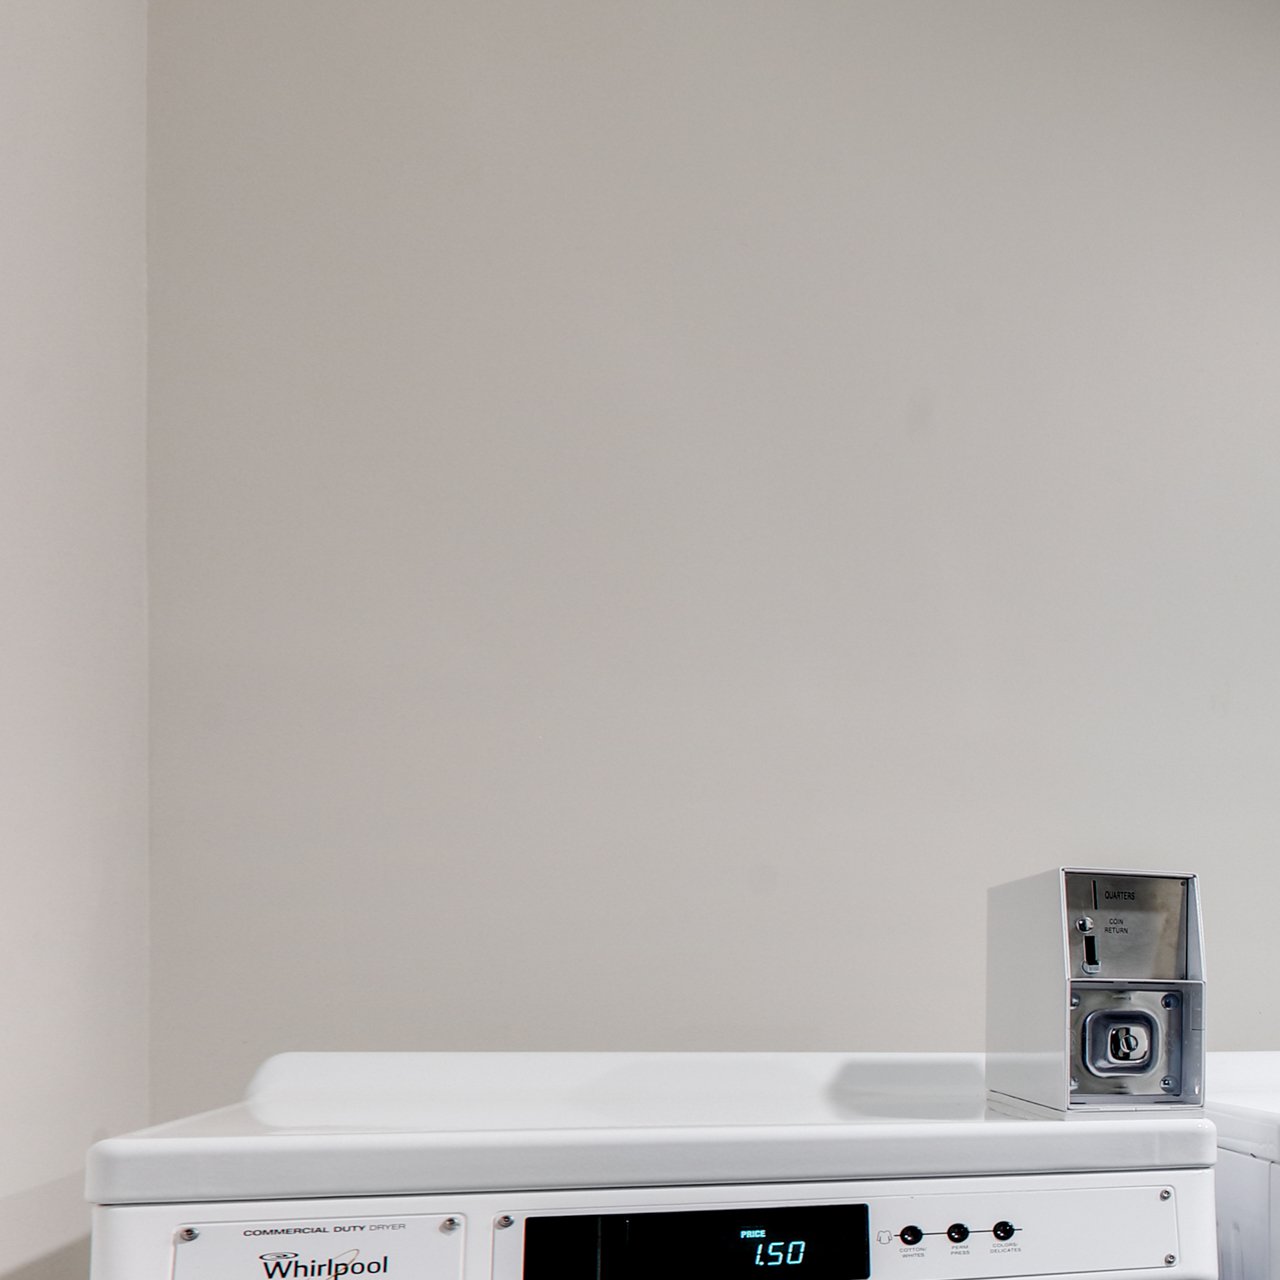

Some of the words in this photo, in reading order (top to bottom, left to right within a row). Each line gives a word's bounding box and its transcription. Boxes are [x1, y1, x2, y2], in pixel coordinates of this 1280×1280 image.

[1104, 890, 1135, 900] QUARTERS
[1104, 926, 1129, 934] RETURN
[243, 1227, 330, 1237] COMMERCIAL
[333, 1225, 367, 1233] DUTY
[369, 1223, 407, 1231] DRYER
[740, 1229, 766, 1239] PRICE
[755, 1241, 806, 1266] 1.50
[263, 1255, 388, 1280] Whirlpool
